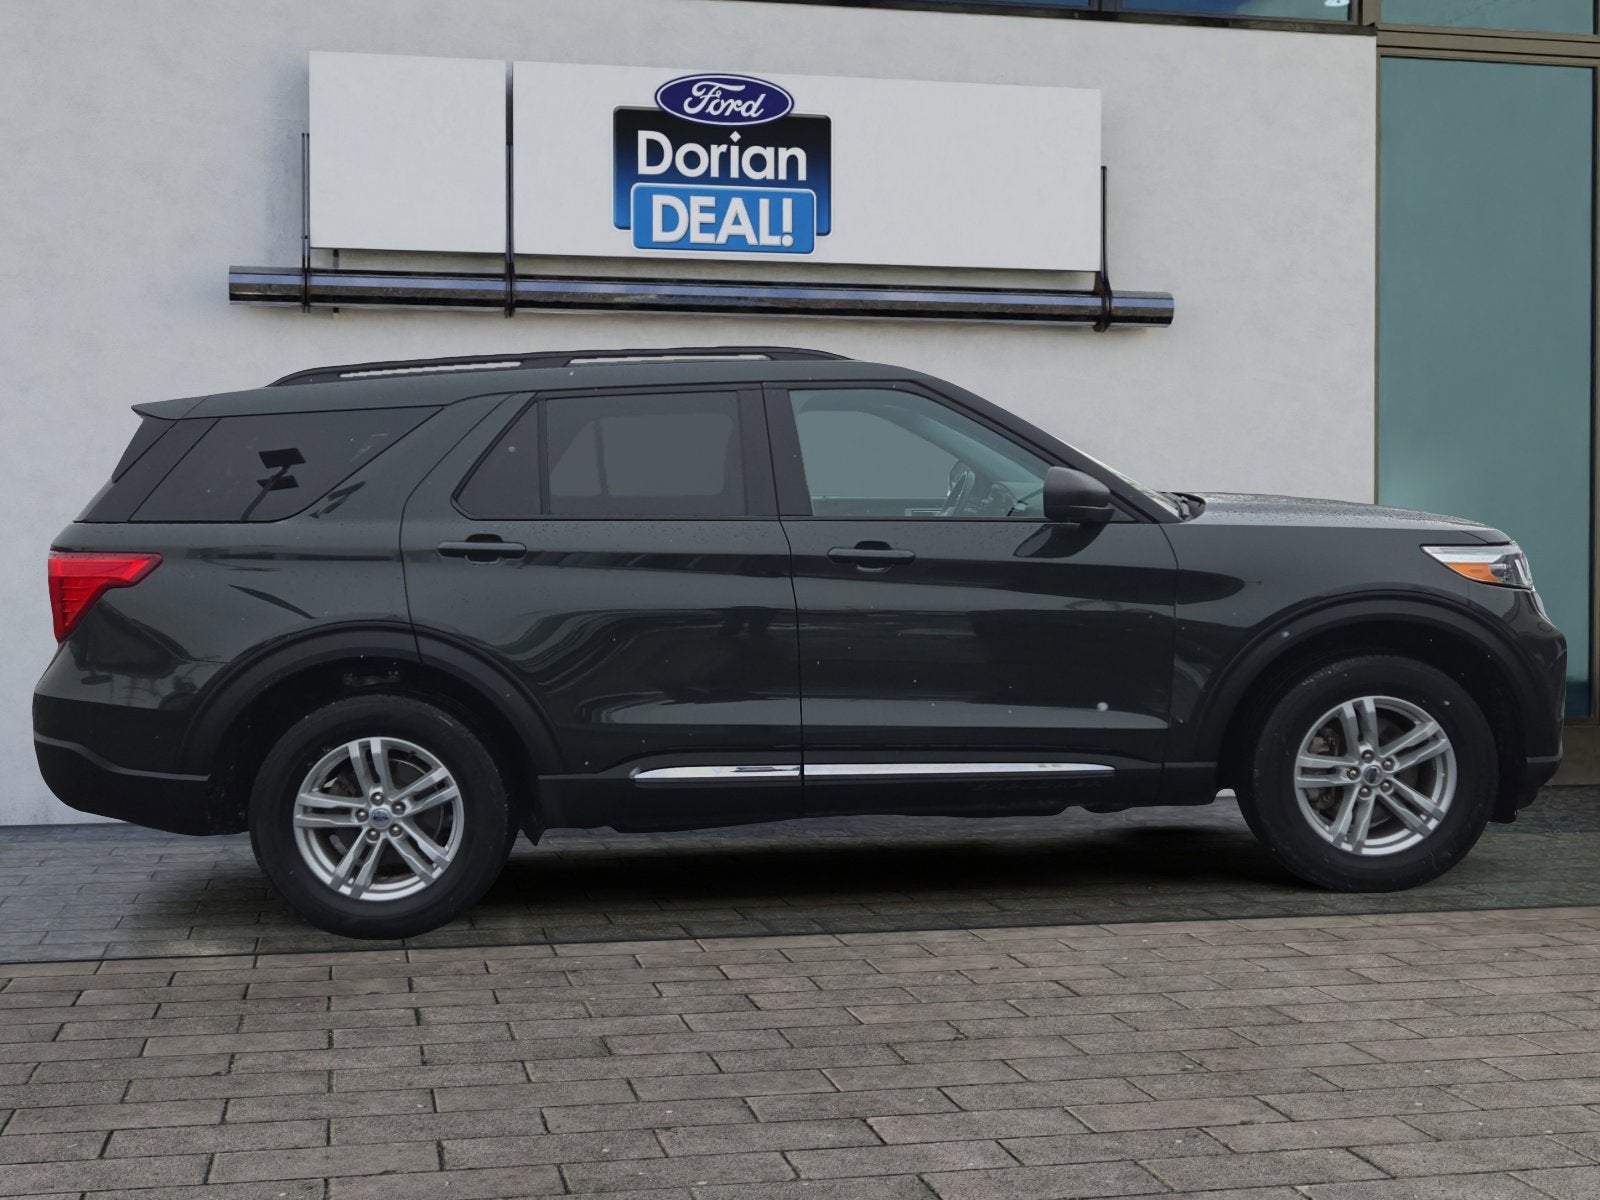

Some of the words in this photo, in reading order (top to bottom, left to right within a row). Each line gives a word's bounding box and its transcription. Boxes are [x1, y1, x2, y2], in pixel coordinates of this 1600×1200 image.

[683, 81, 766, 117] Ford
[637, 130, 807, 181] Dorian
[652, 194, 793, 247] DEAL!
